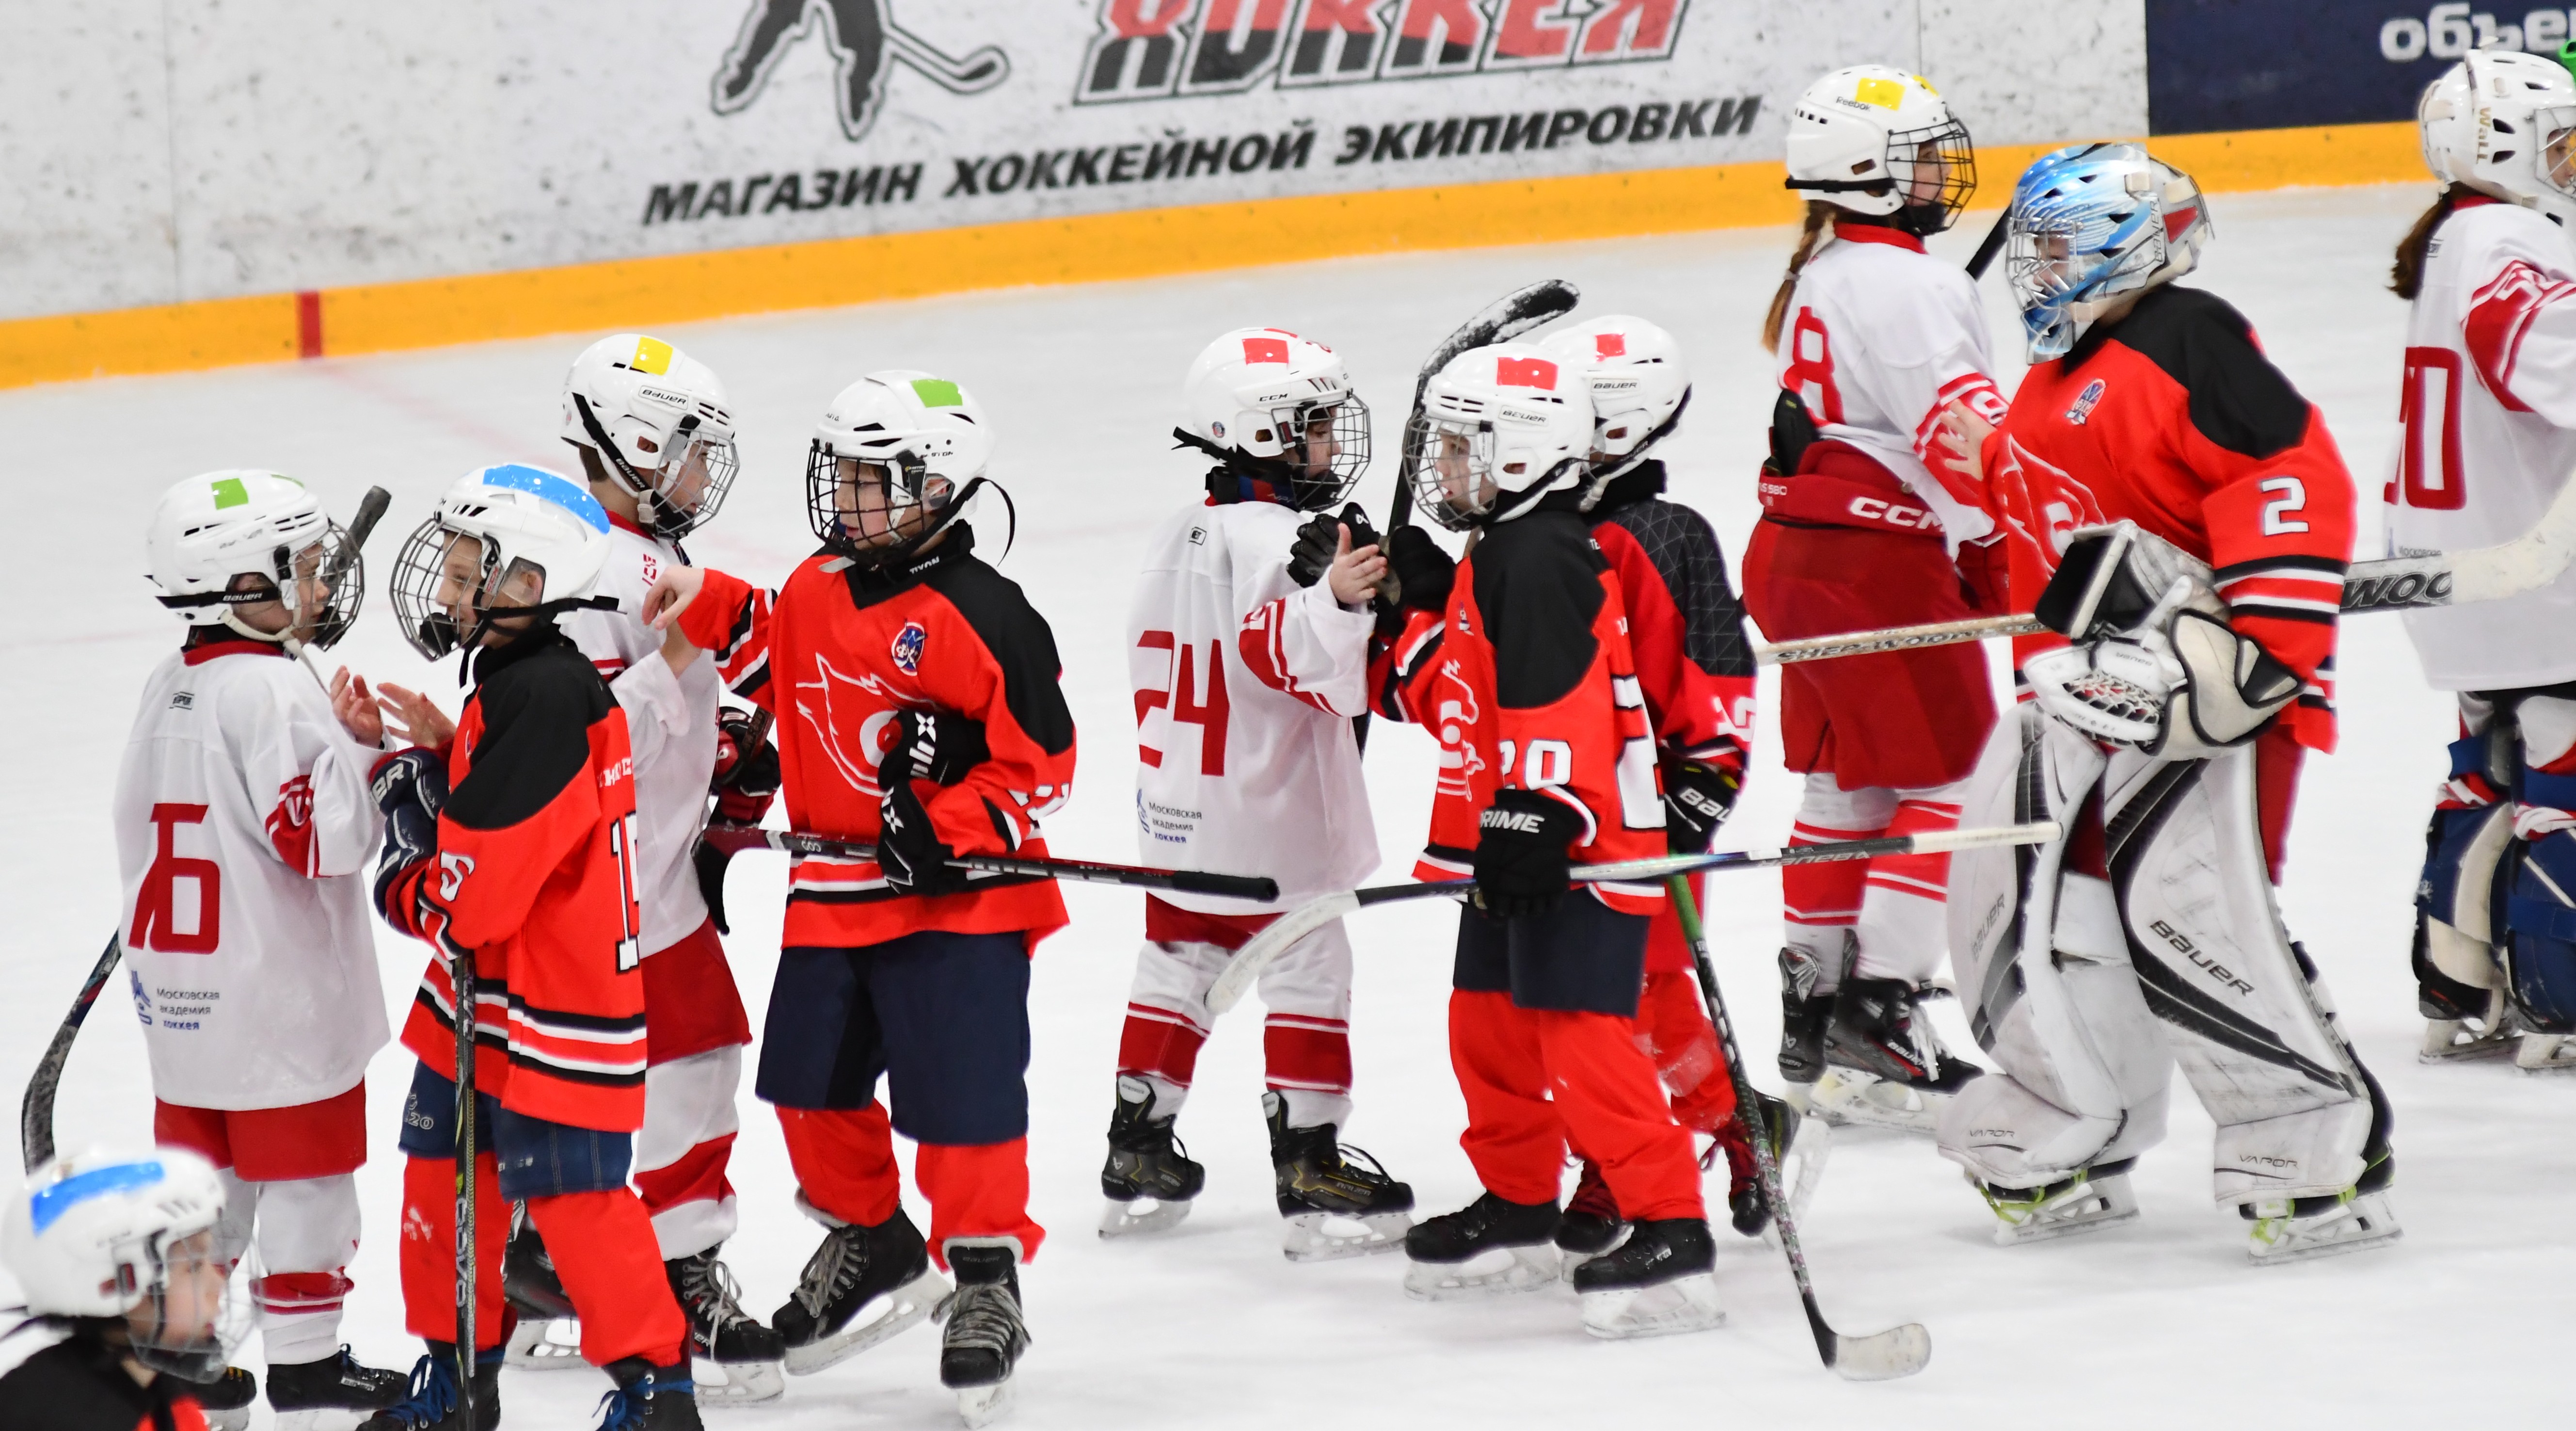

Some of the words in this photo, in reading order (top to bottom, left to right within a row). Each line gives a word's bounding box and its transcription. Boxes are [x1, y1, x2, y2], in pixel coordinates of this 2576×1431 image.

[2380, 4, 2576, 62] объе
[1836, 96, 1872, 112] Reebok
[641, 162, 922, 226] МАГАЗИН
[944, 118, 1317, 199] ХОККЕЙНОЙ
[1334, 95, 1764, 166] ЭКИПИРОВКИ
[1259, 388, 1288, 402] CCM
[2260, 476, 2309, 536] 2
[1134, 630, 1230, 777] 24
[1148, 802, 1203, 820] Московская
[1480, 810, 1545, 834] RIME
[157, 987, 221, 1001] Московская
[1969, 1129, 2016, 1140] VAPOR
[2239, 1155, 2300, 1170] VAPOR
